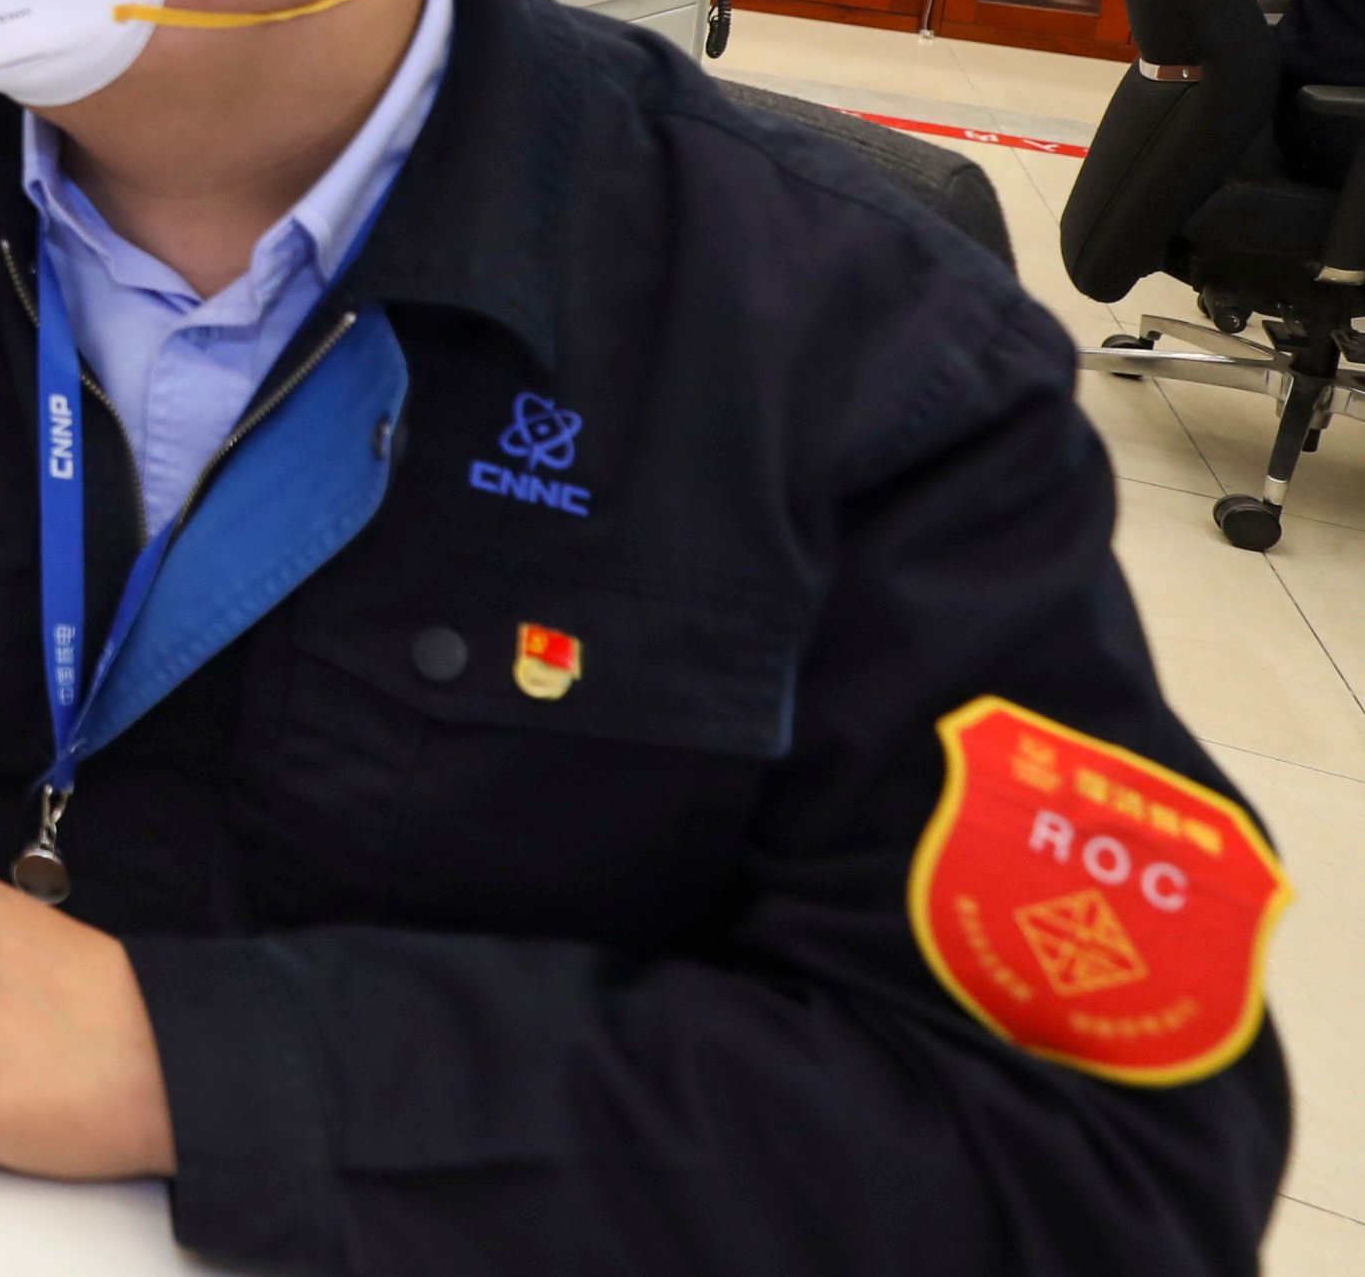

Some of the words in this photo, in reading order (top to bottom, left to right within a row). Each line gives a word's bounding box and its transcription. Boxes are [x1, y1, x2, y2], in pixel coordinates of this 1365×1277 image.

[49, 393, 74, 480] CNNP
[469, 460, 592, 518] CNNC
[1027, 808, 1190, 913] ROC
